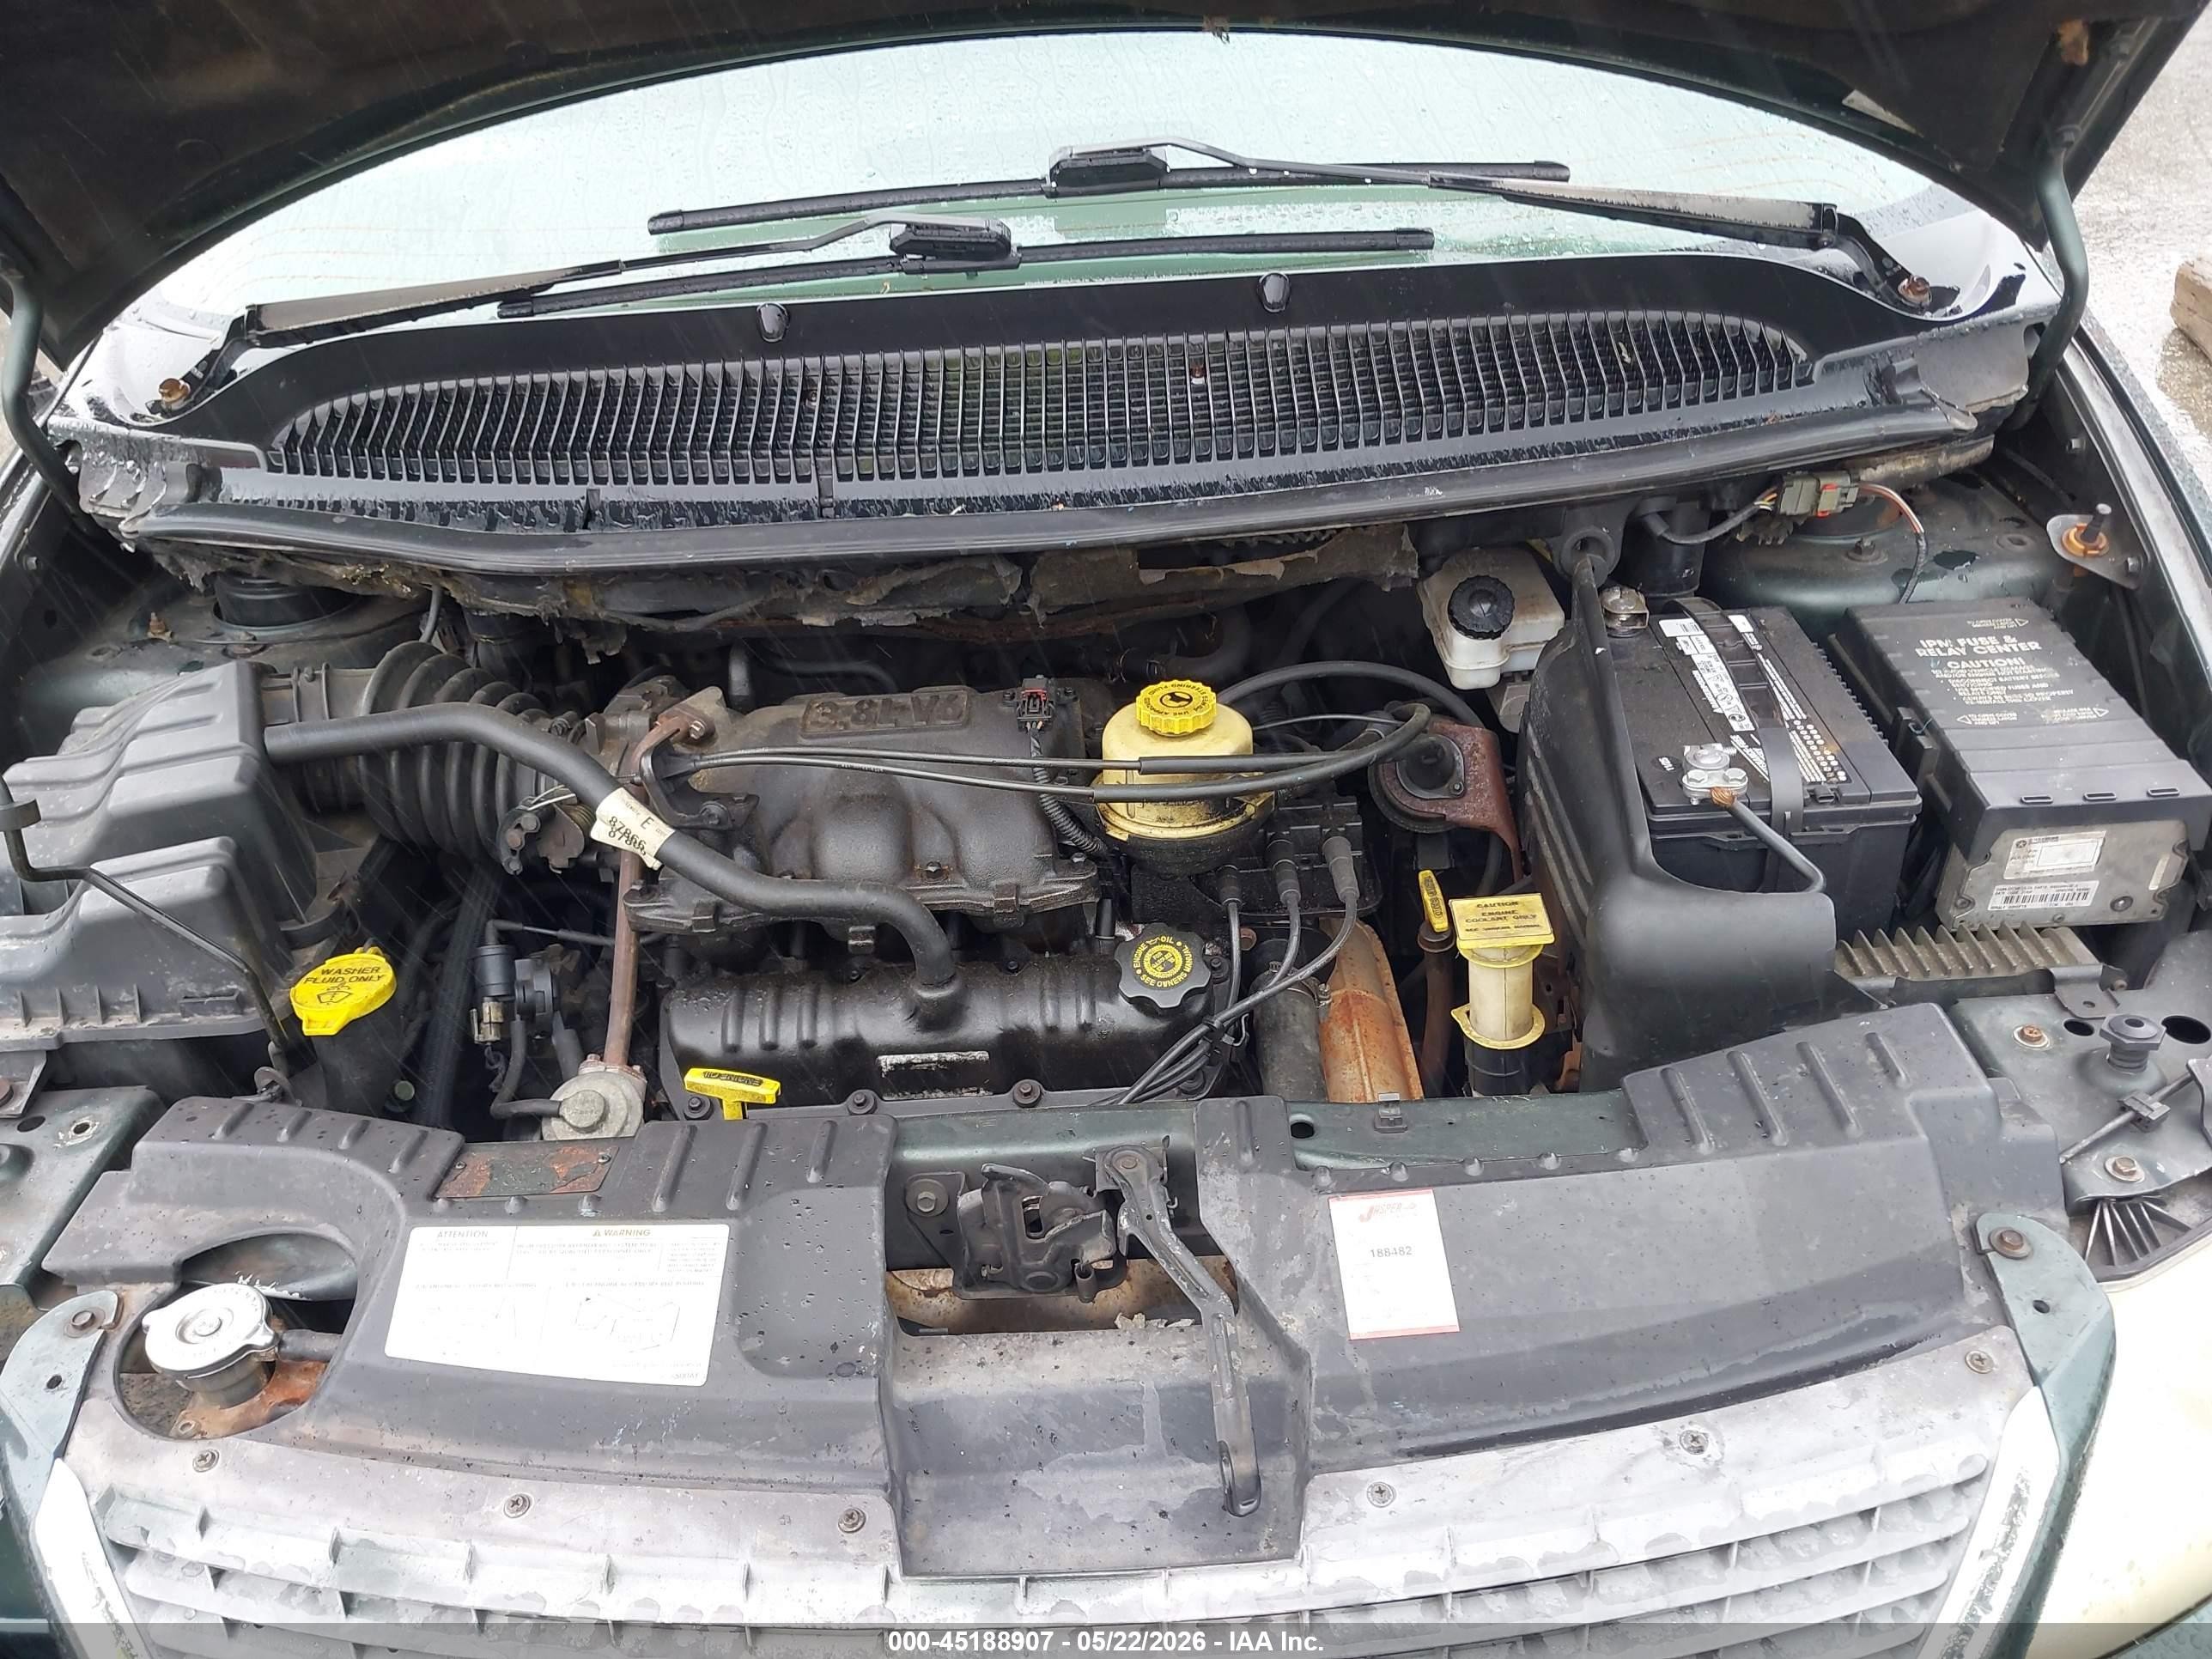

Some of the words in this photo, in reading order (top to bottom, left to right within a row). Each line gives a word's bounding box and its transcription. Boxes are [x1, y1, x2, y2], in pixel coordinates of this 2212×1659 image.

[1957, 636, 1999, 647] FUSE
[2003, 635, 2018, 644] &
[1915, 647, 1966, 657] RELAY
[1972, 641, 2042, 654] CENTER
[1947, 657, 2026, 669] CAUTION!
[640, 817, 654, 830] E
[1133, 942, 1148, 969] ENGINE
[1160, 935, 1175, 944] OIL
[321, 967, 380, 975] WASHER
[349, 975, 385, 983] ONLY
[1139, 974, 1156, 987] SEE
[1156, 972, 1188, 988] OWNERS
[436, 1229, 489, 1239] ATTENTION
[603, 1229, 652, 1238] WARNING
